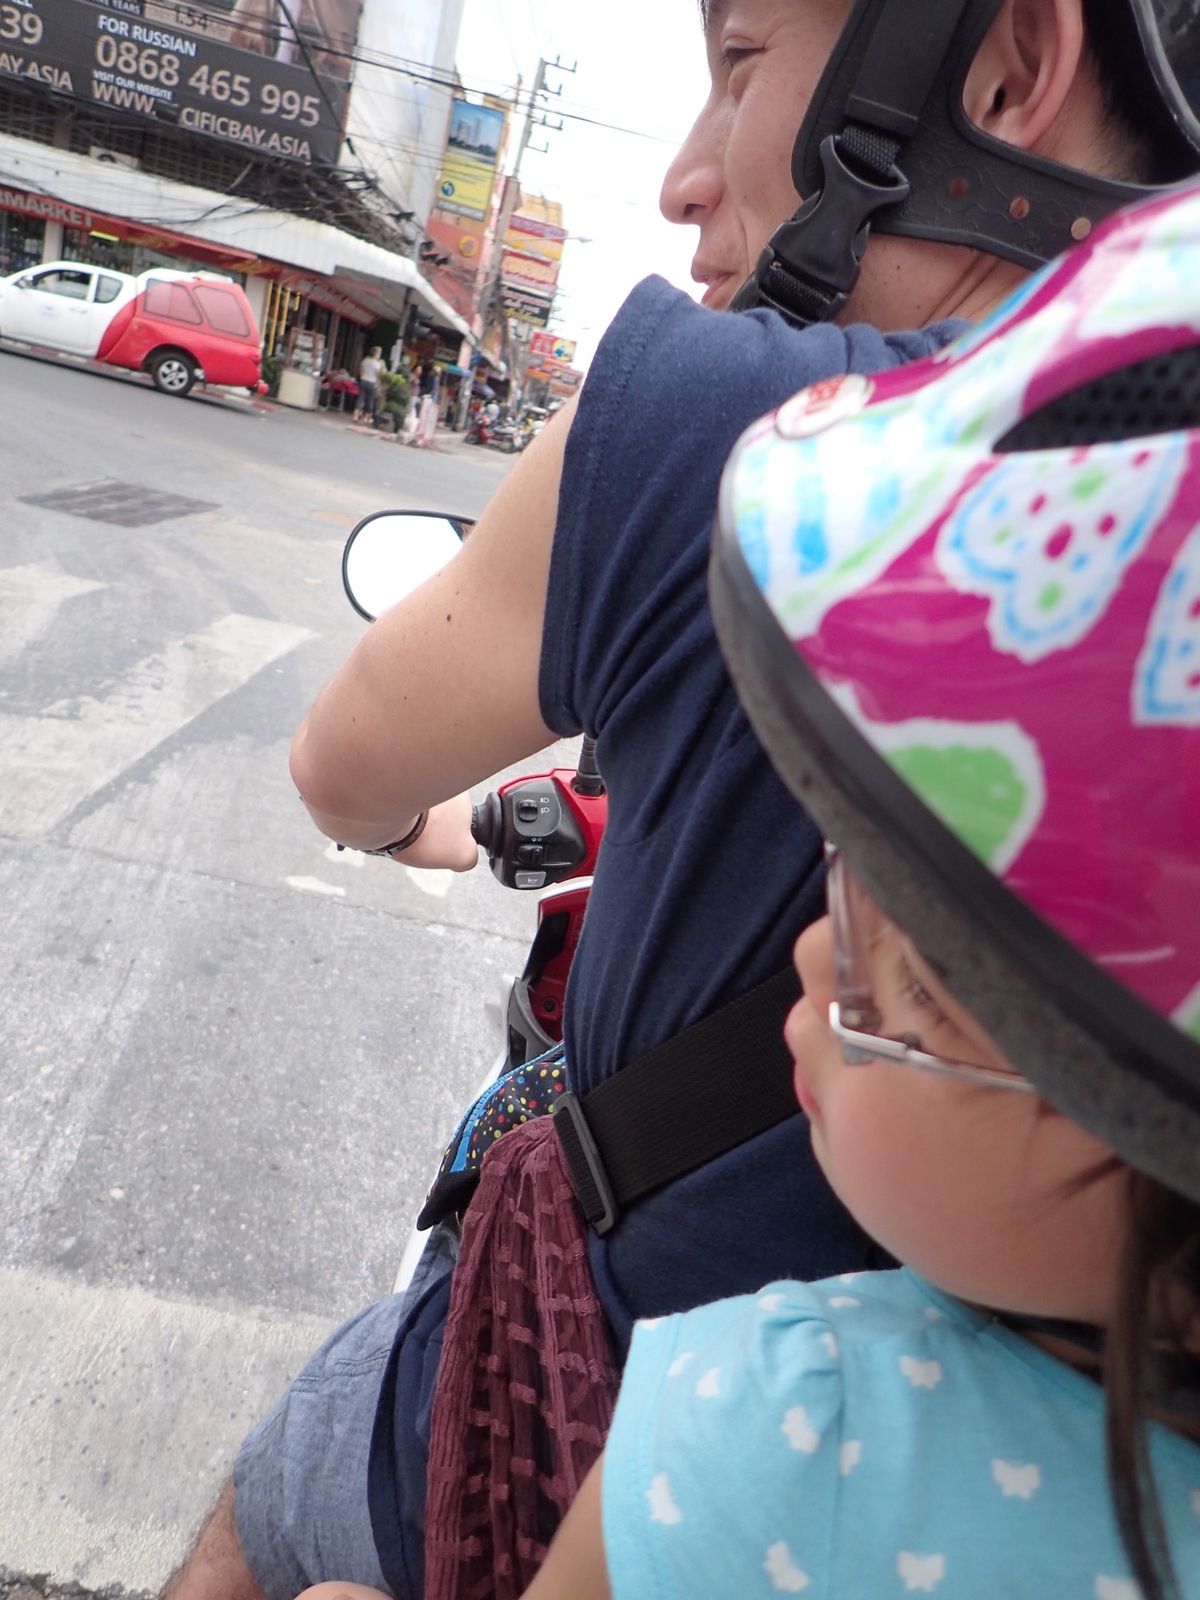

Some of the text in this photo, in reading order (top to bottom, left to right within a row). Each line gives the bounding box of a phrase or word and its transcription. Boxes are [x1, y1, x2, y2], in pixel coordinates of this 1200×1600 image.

[0, 5, 43, 45] 39
[97, 14, 197, 57] FOR RUSSIAN
[0, 52, 74, 93] AYASIA
[92, 69, 173, 101] VISIT OUR WEBSITE
[96, 34, 320, 127] 0868 465 995
